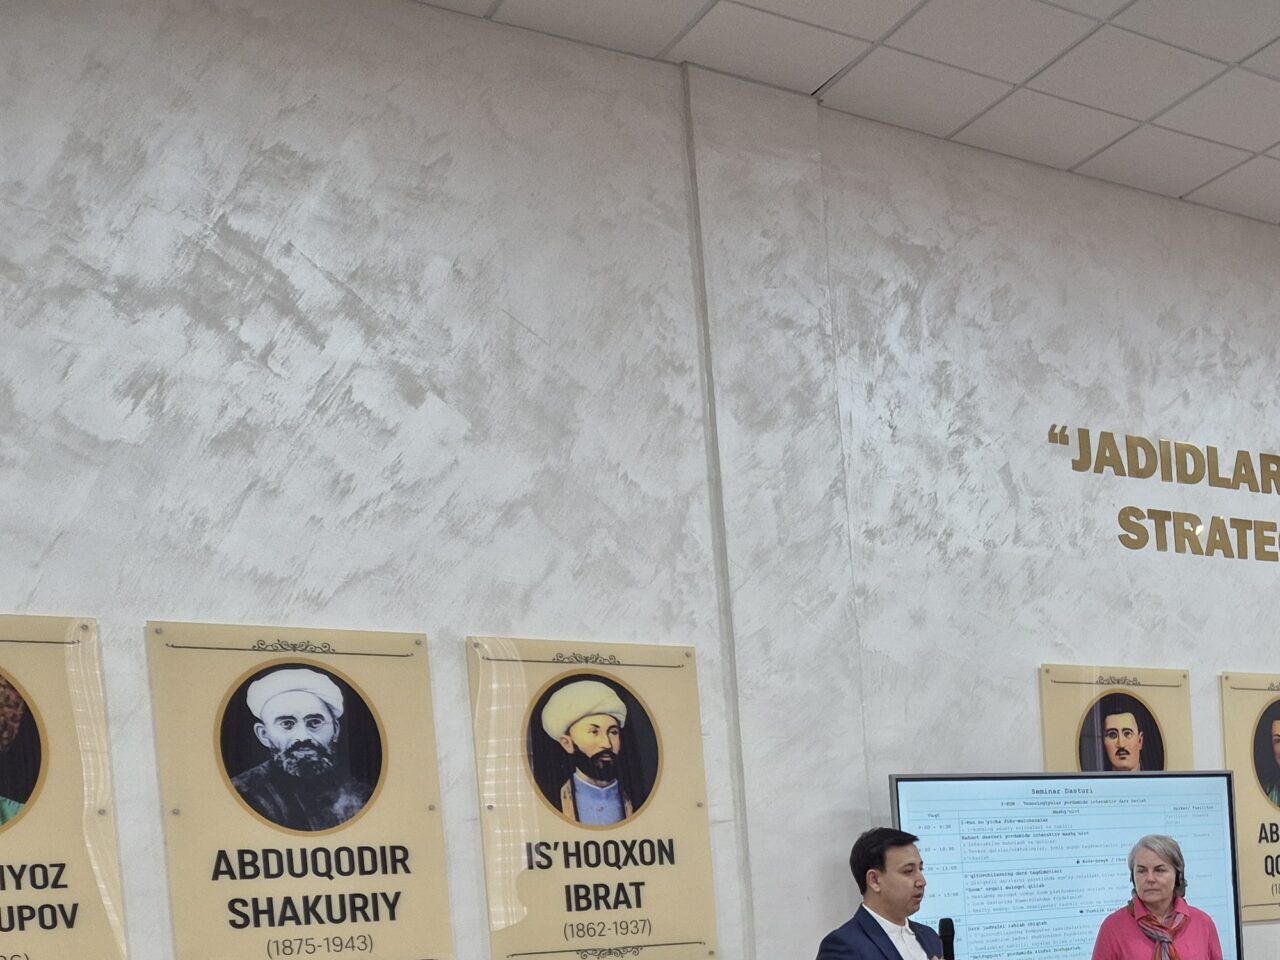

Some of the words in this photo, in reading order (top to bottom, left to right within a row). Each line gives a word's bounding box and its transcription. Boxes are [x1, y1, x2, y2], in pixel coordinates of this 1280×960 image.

[211, 844, 412, 883] ABDUQODIR
[227, 891, 402, 930] SHAKURIY
[564, 881, 645, 913] IBRAT
[563, 917, 652, 940] (1862-1937)
[266, 933, 374, 960] (1875-1943)
